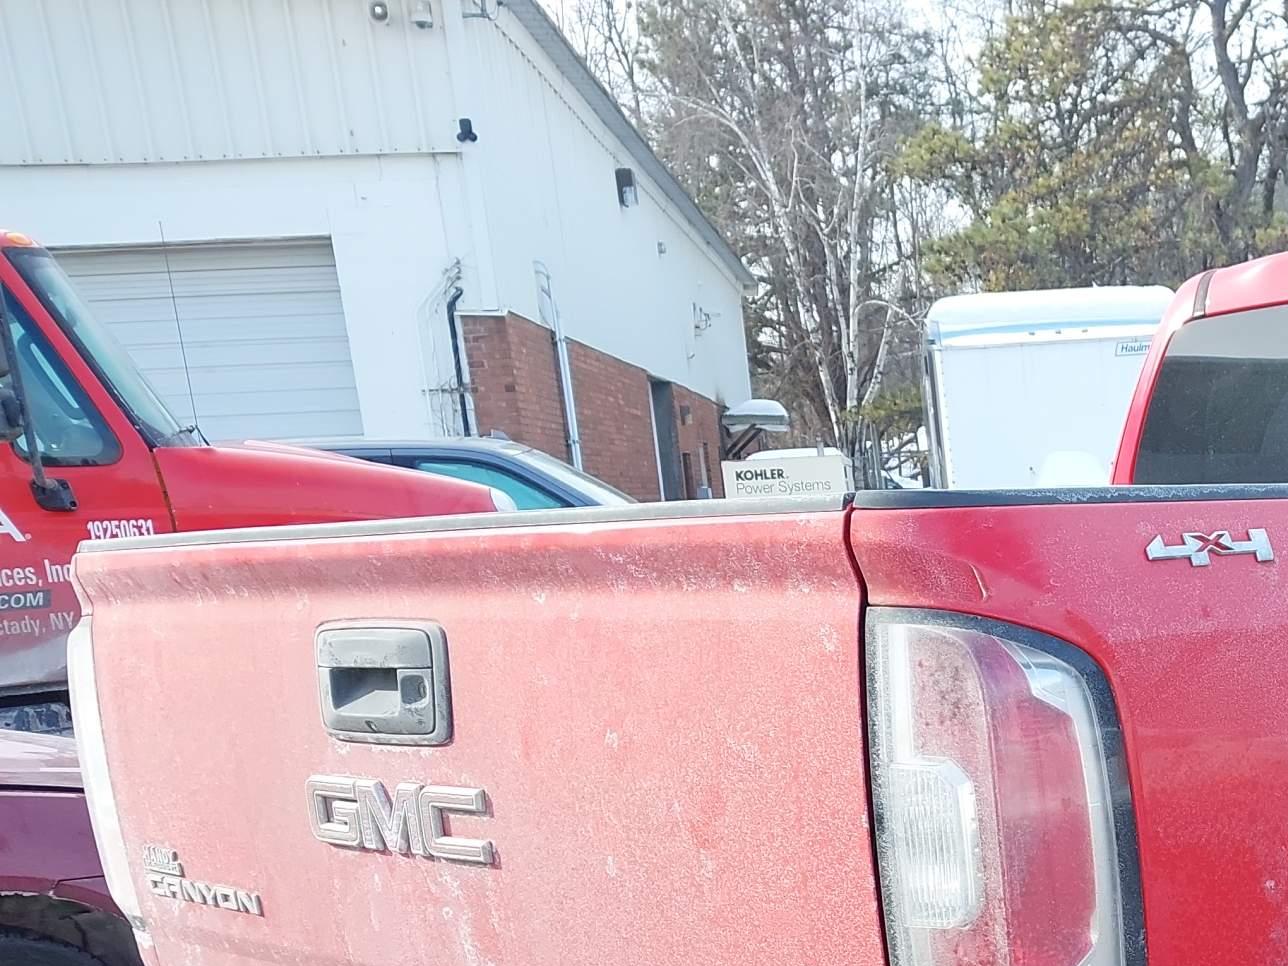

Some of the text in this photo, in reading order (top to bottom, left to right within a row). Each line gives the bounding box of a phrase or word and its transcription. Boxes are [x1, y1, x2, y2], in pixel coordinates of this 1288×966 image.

[735, 469, 785, 481] KOHLER
[736, 480, 832, 495] Power Systems
[87, 519, 154, 540] 19250631
[48, 611, 74, 631] NY
[305, 774, 496, 866] GMC
[148, 875, 264, 916] CANYON
